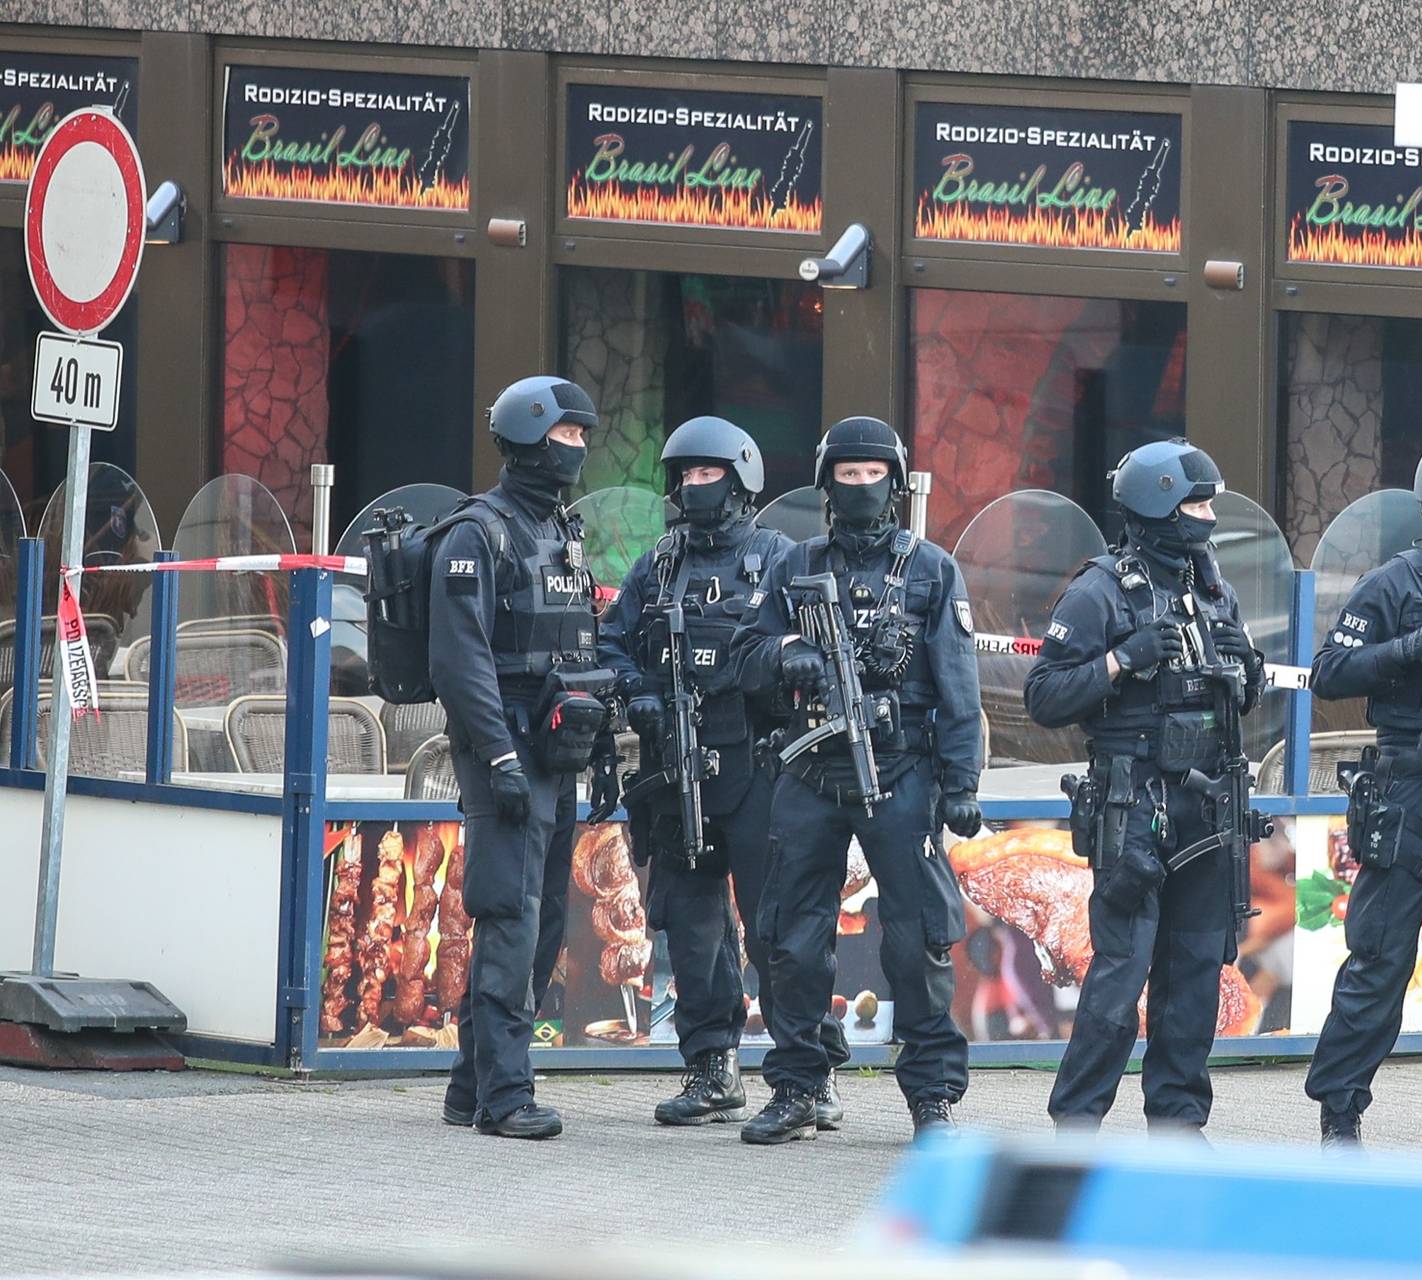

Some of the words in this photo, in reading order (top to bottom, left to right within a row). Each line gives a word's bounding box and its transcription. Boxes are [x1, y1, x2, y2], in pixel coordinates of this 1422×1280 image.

[245, 84, 447, 113] RODIZIO-SPEZIALITÄT
[588, 103, 800, 133] RODIZIO-SPEZIALITÄT
[241, 114, 346, 163] Brasil
[936, 122, 1156, 152] RODIZIO-SPEZIALITÄT
[585, 133, 694, 183] Brasil
[933, 153, 1047, 204] Brasil
[51, 357, 78, 404] 40
[83, 372, 101, 408] m
[450, 560, 475, 573] BFE
[1342, 612, 1368, 633] BFE
